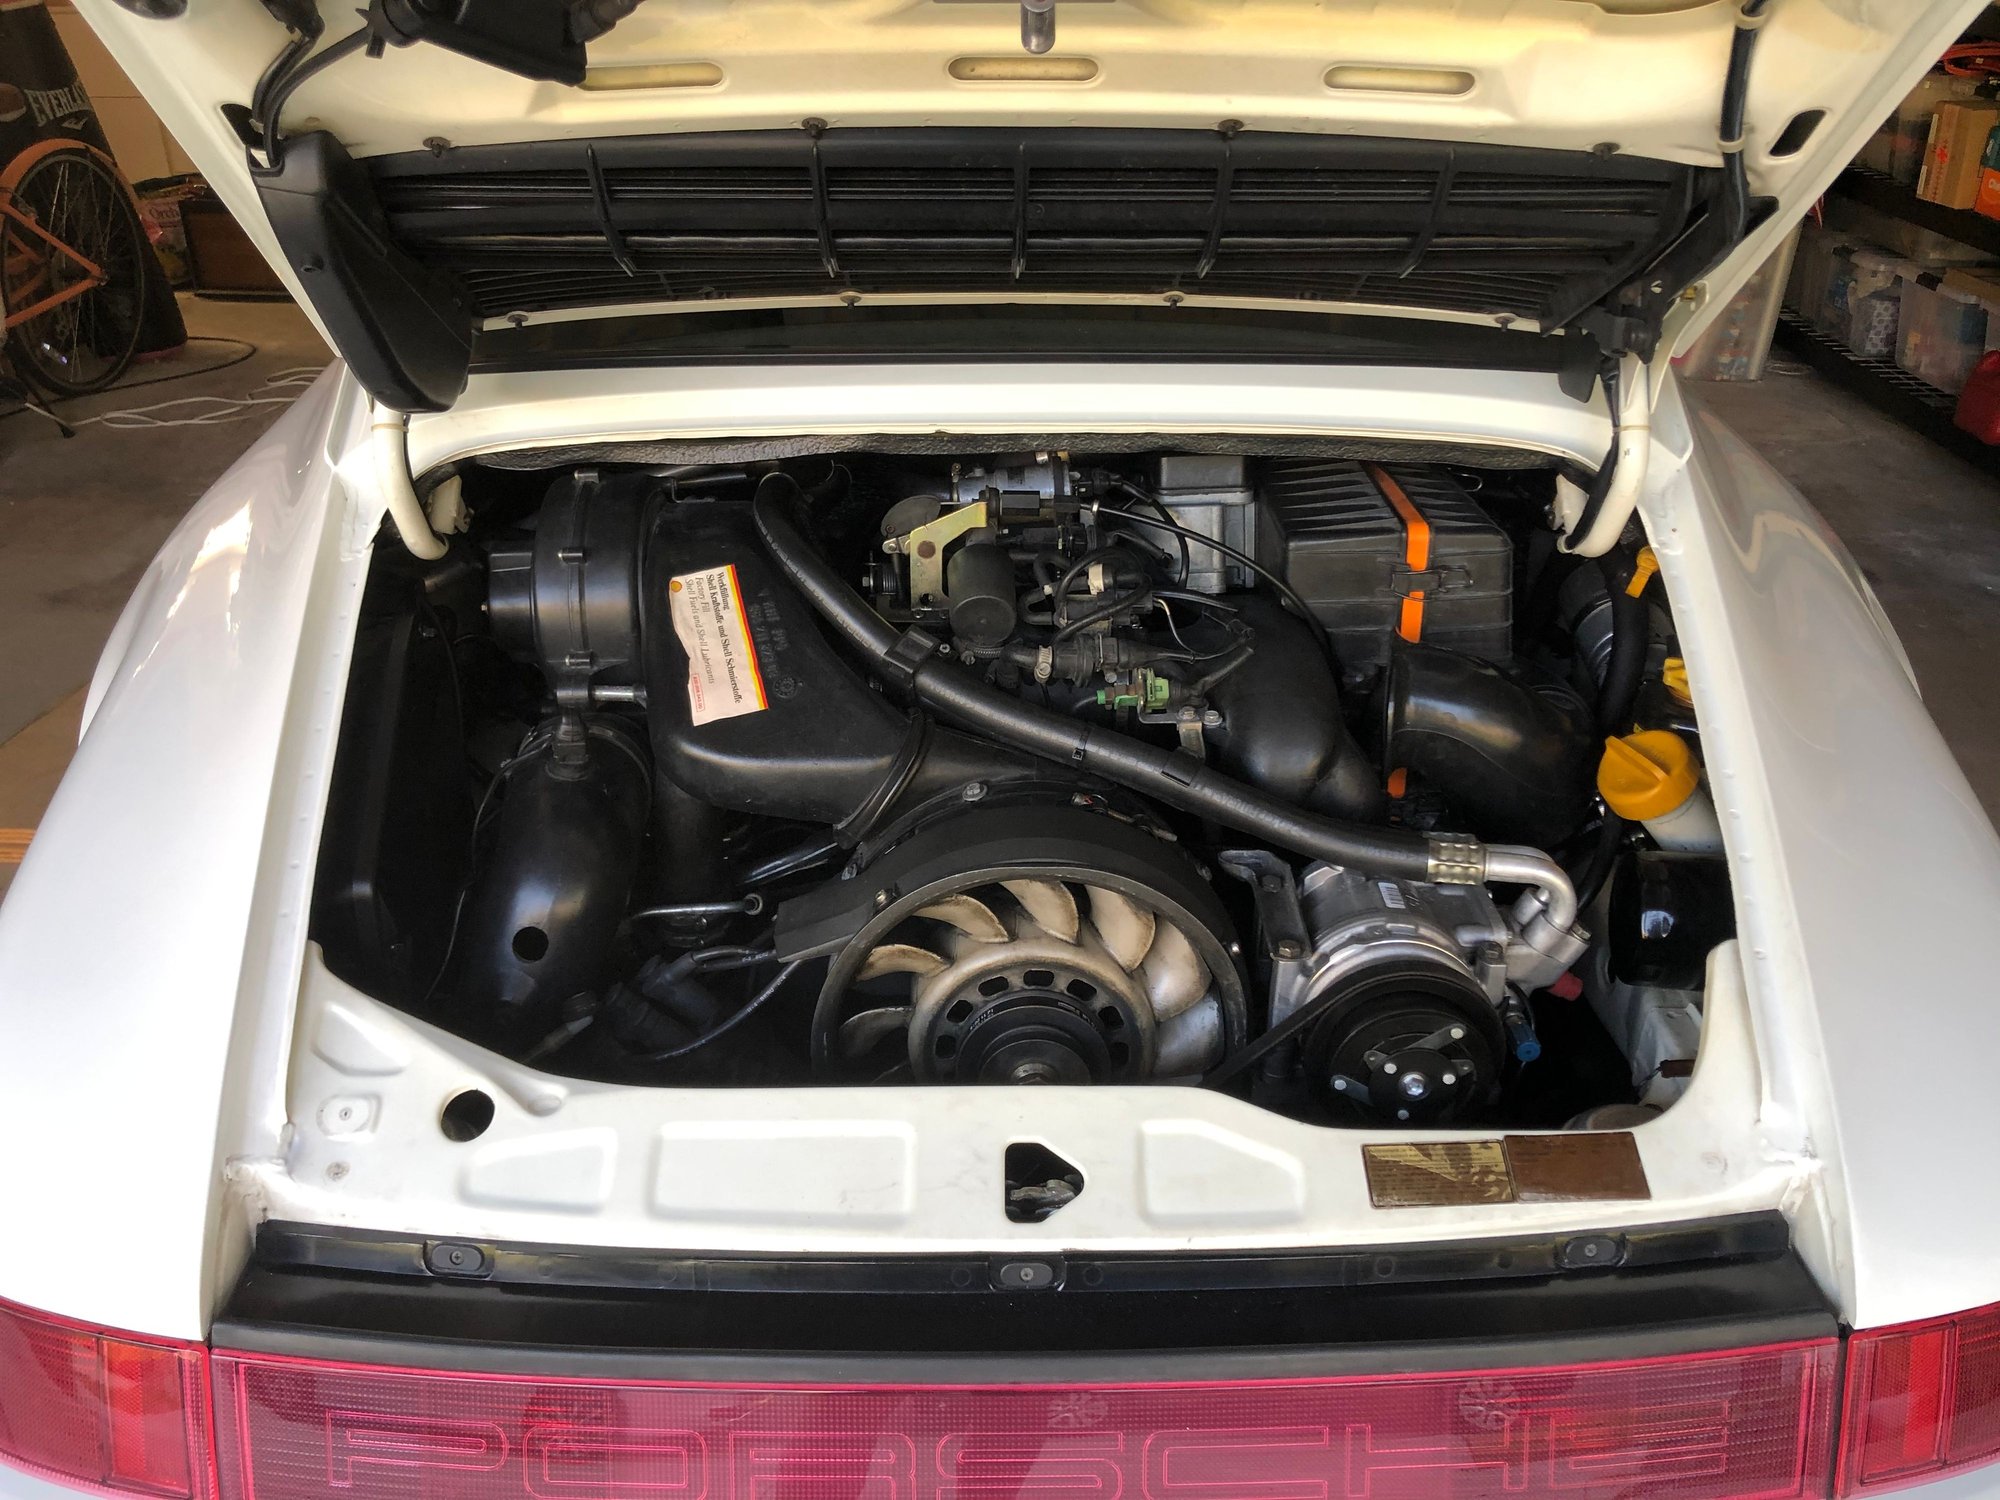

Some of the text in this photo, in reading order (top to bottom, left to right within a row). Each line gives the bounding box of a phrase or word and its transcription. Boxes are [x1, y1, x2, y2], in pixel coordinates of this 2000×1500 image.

[695, 577, 710, 613] Factory Fill
[717, 571, 730, 611] Werkfüllung
[685, 579, 715, 684] Shell Fuels and Shell Lubricants
[706, 574, 743, 704] Shell Kraftstoffe und Shell Schmierstoffe
